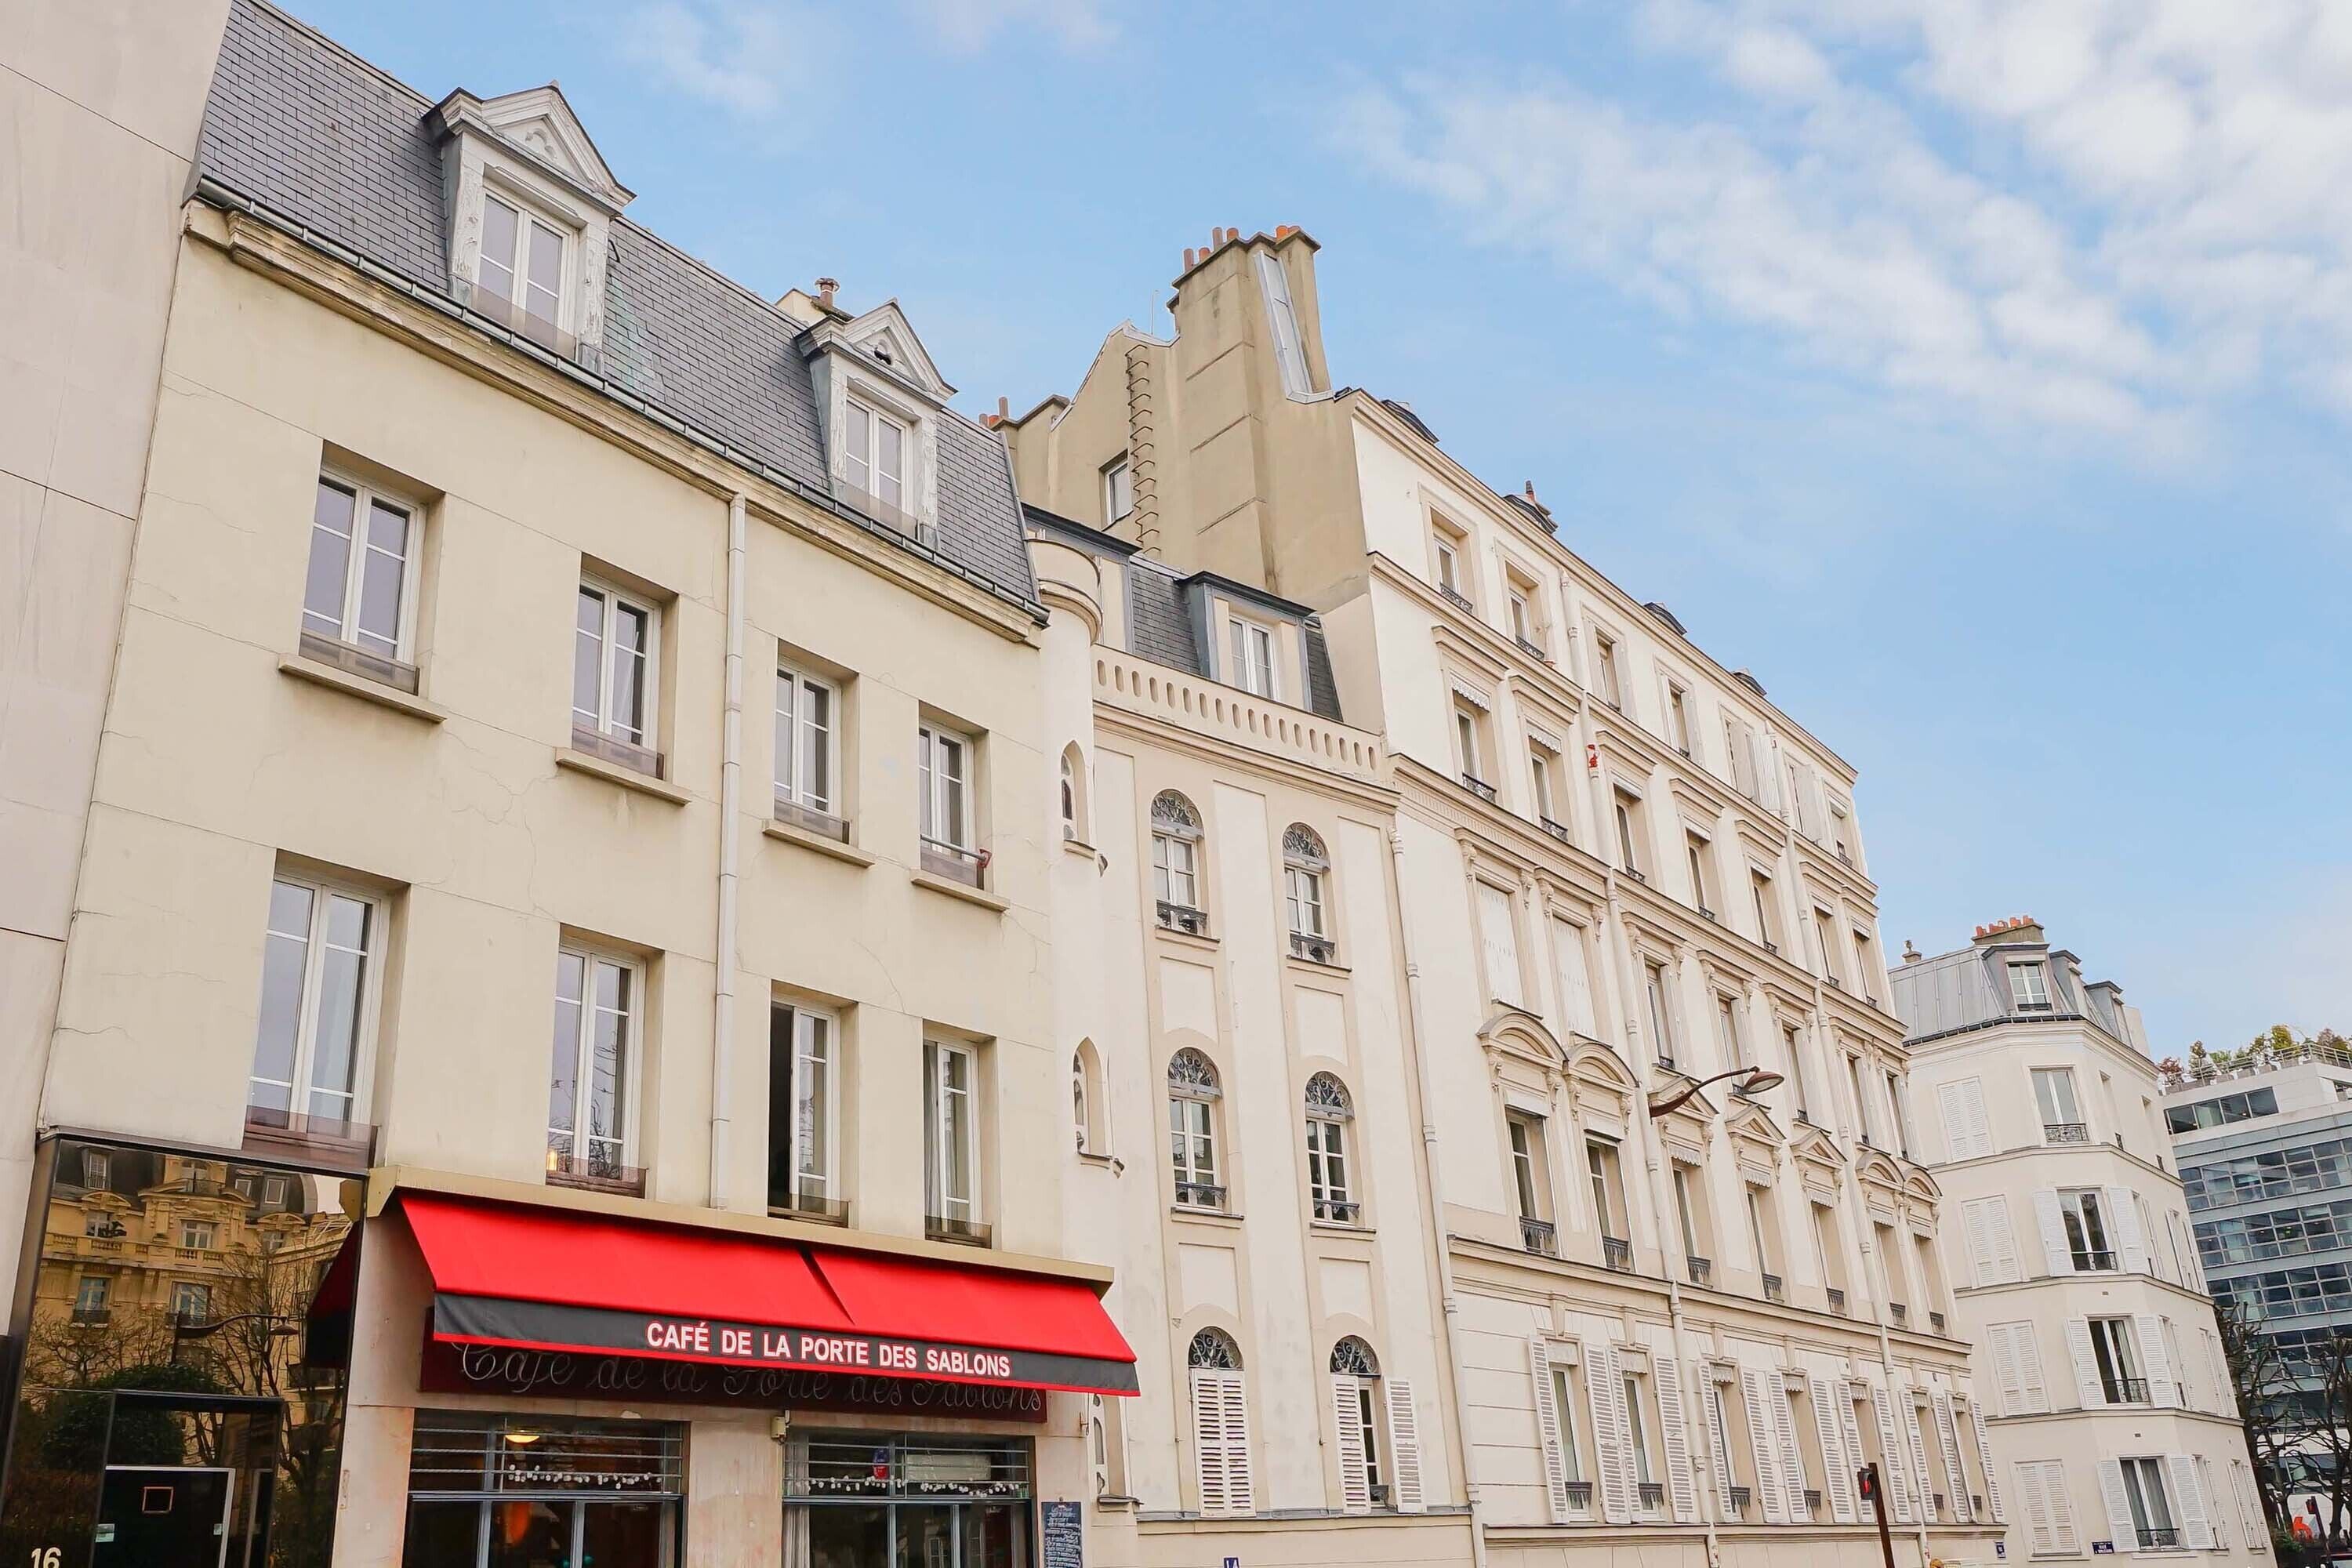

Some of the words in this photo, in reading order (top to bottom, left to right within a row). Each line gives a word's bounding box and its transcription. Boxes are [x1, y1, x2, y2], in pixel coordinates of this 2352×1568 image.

[647, 1322, 710, 1352] CAFÉ
[722, 1330, 753, 1355] DE
[764, 1334, 791, 1358] LA
[801, 1336, 869, 1365] PORTE
[879, 1344, 917, 1369] DES
[927, 1348, 1011, 1377] SABLONS
[586, 1356, 648, 1390] de
[31, 1547, 62, 1568] 16
